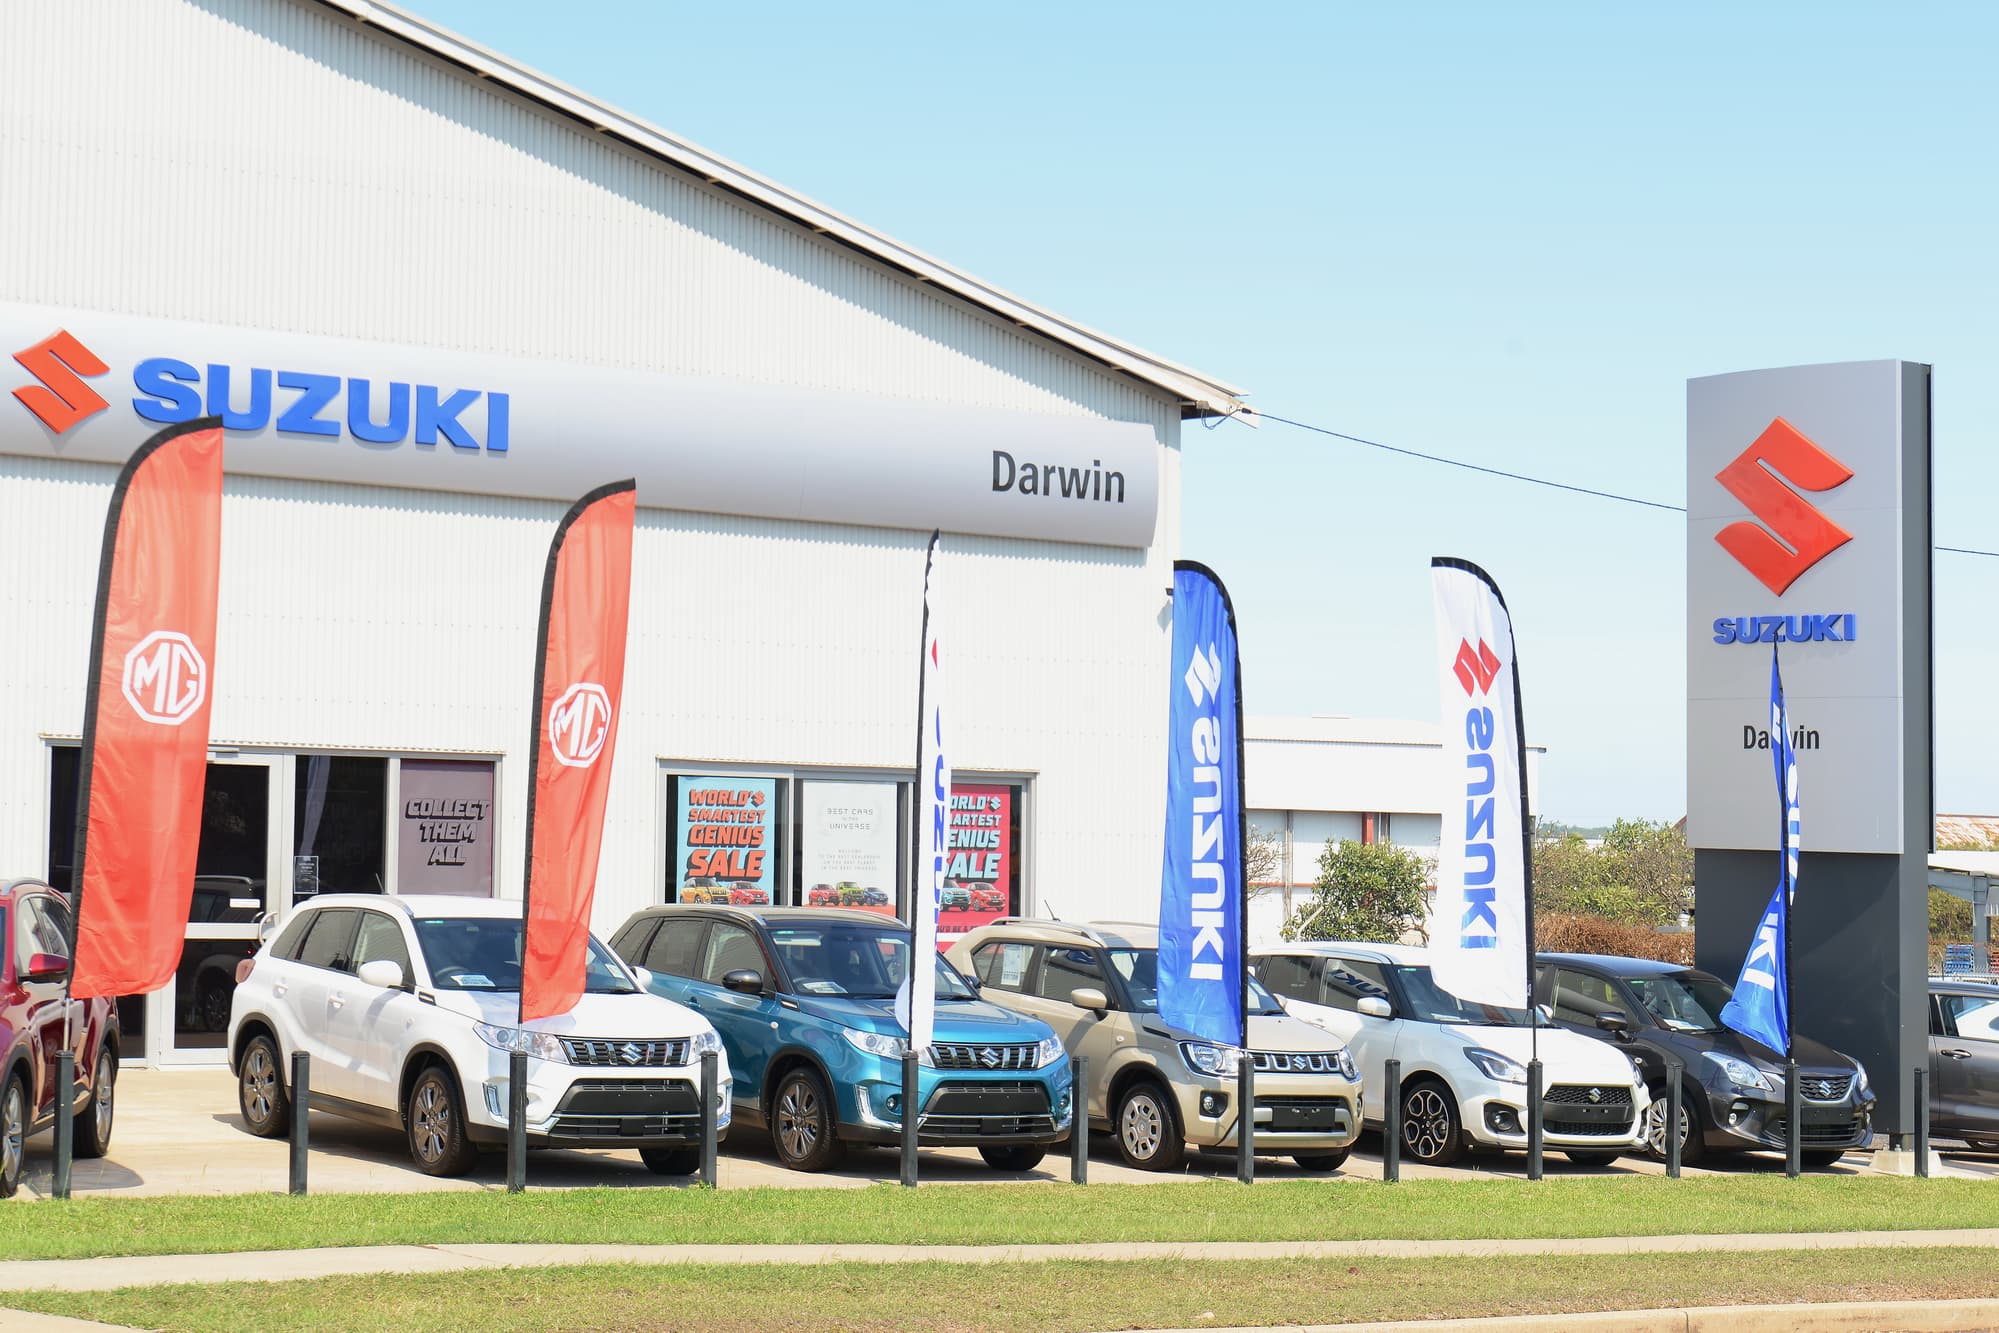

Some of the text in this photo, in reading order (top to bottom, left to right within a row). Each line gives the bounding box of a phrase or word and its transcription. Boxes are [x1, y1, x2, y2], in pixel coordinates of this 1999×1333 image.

[132, 357, 509, 451] SUZUKI
[992, 450, 1125, 503] Darwin
[1713, 614, 1857, 644] SUZUKI
[133, 641, 199, 714] MG
[553, 691, 606, 757] MG
[1743, 725, 1820, 749] Dain
[405, 799, 490, 820] COLLECT
[688, 808, 766, 823] SMARTEST
[950, 795, 1001, 812] ORLD'S
[419, 821, 477, 843] THEM
[950, 813, 1002, 827] ARTEST
[687, 824, 766, 848] GENIUS
[948, 829, 1001, 850] ENIUS
[427, 845, 467, 866] ALL
[684, 848, 767, 882] SALE
